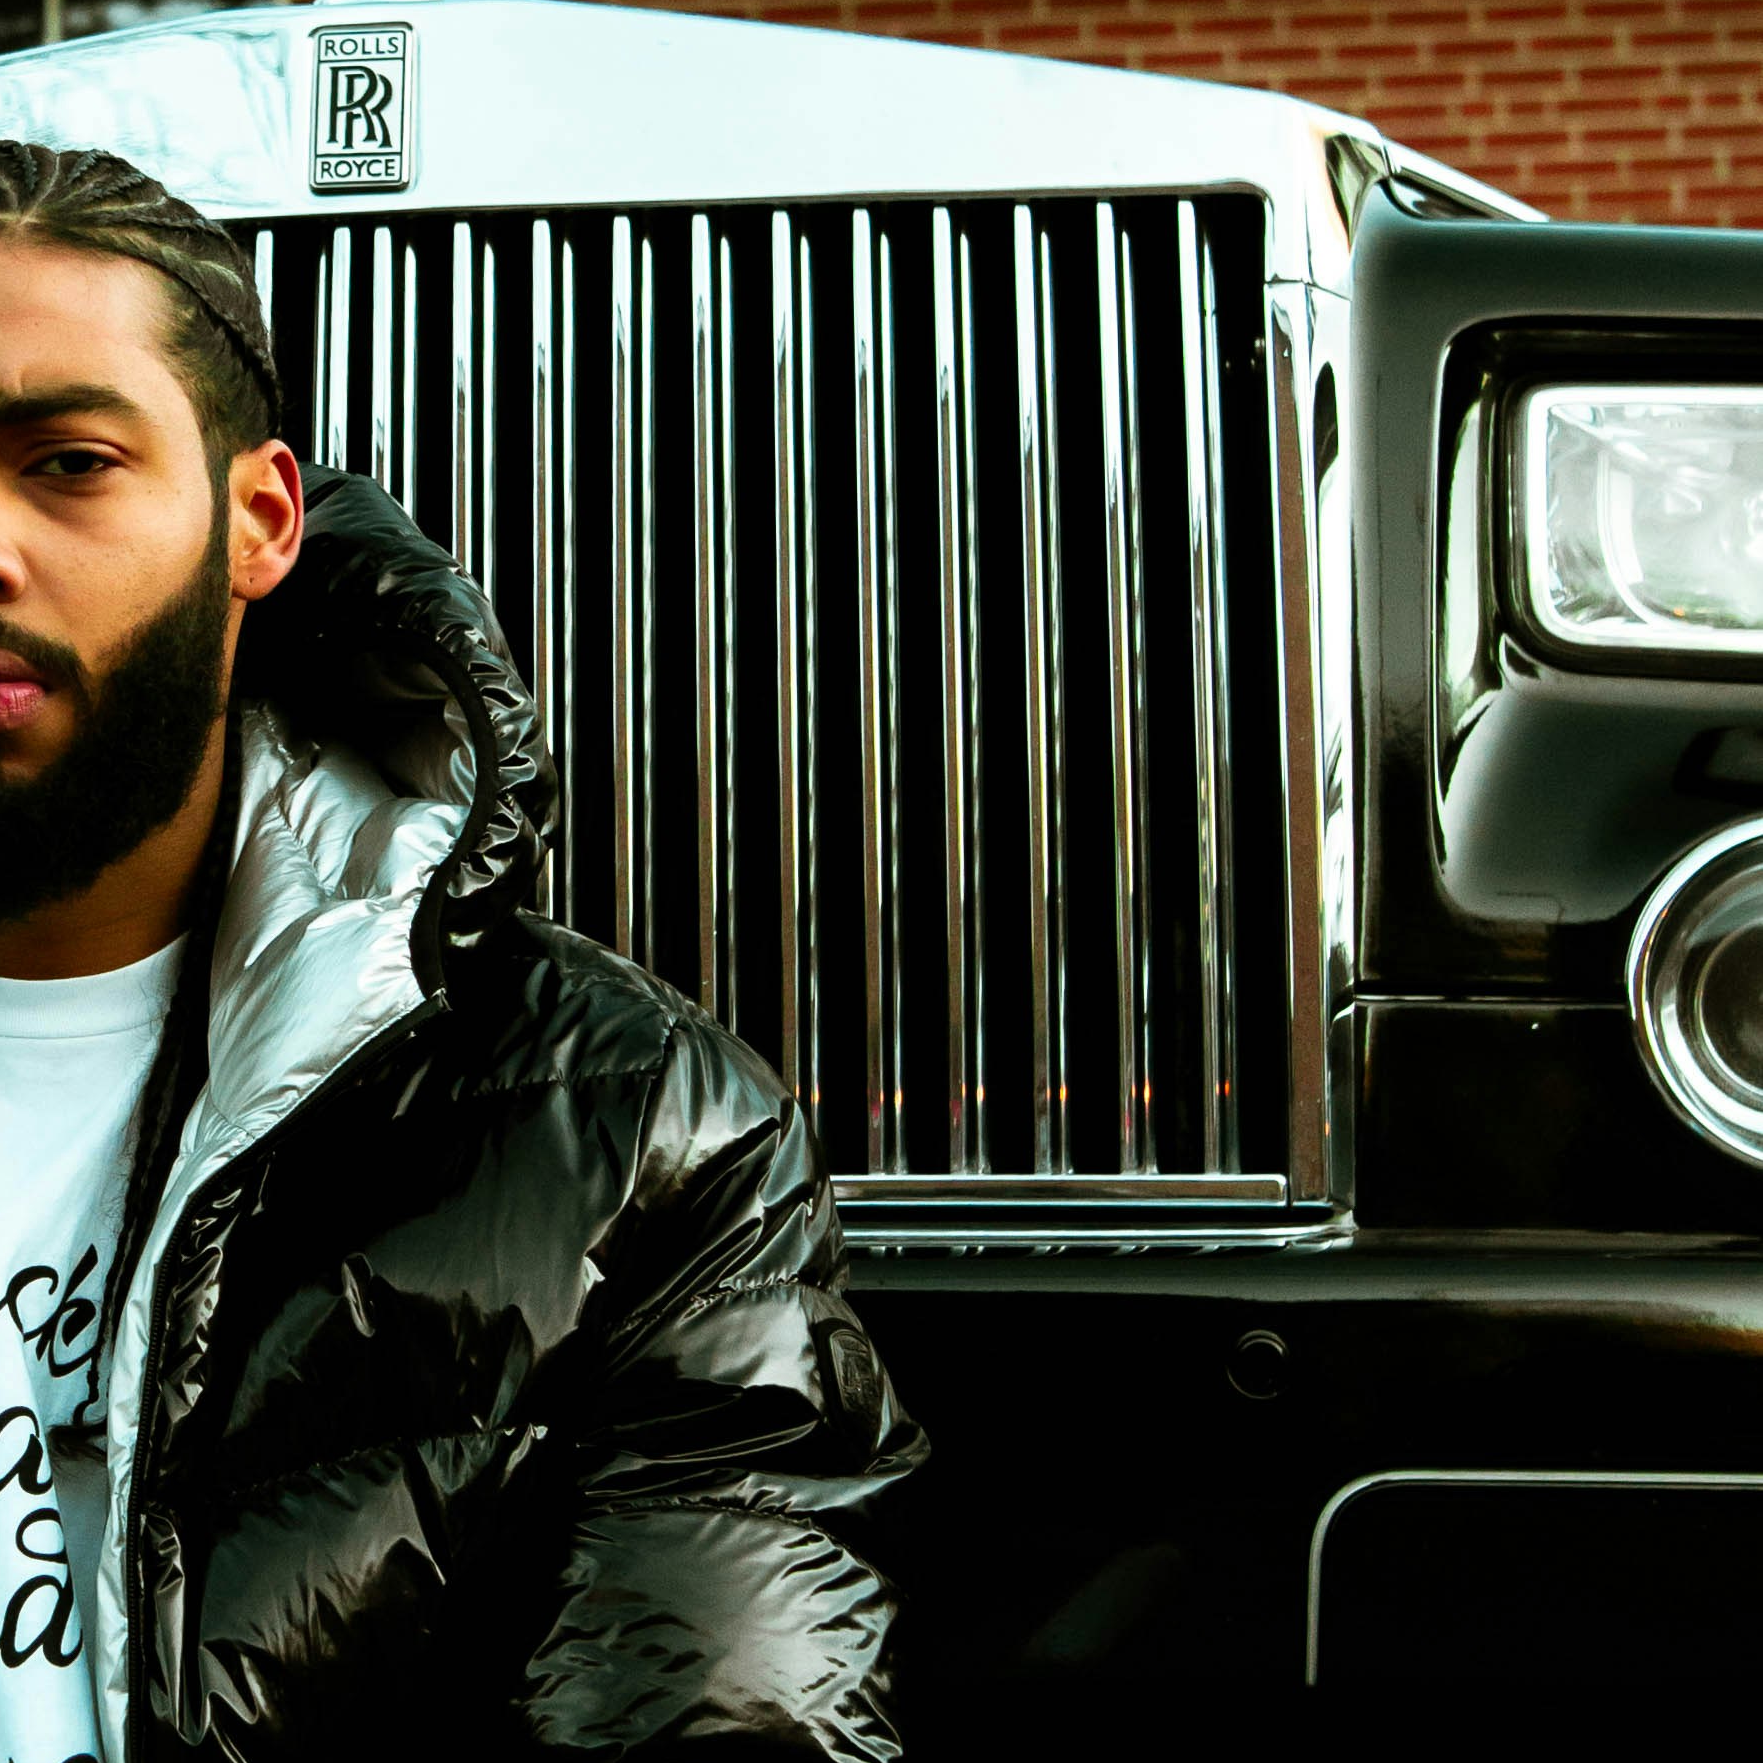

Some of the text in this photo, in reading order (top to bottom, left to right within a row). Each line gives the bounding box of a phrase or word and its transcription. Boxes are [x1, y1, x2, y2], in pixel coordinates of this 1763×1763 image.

[324, 37, 399, 57] ROLLS
[326, 65, 393, 149] RR
[320, 159, 395, 178] ROYCE
